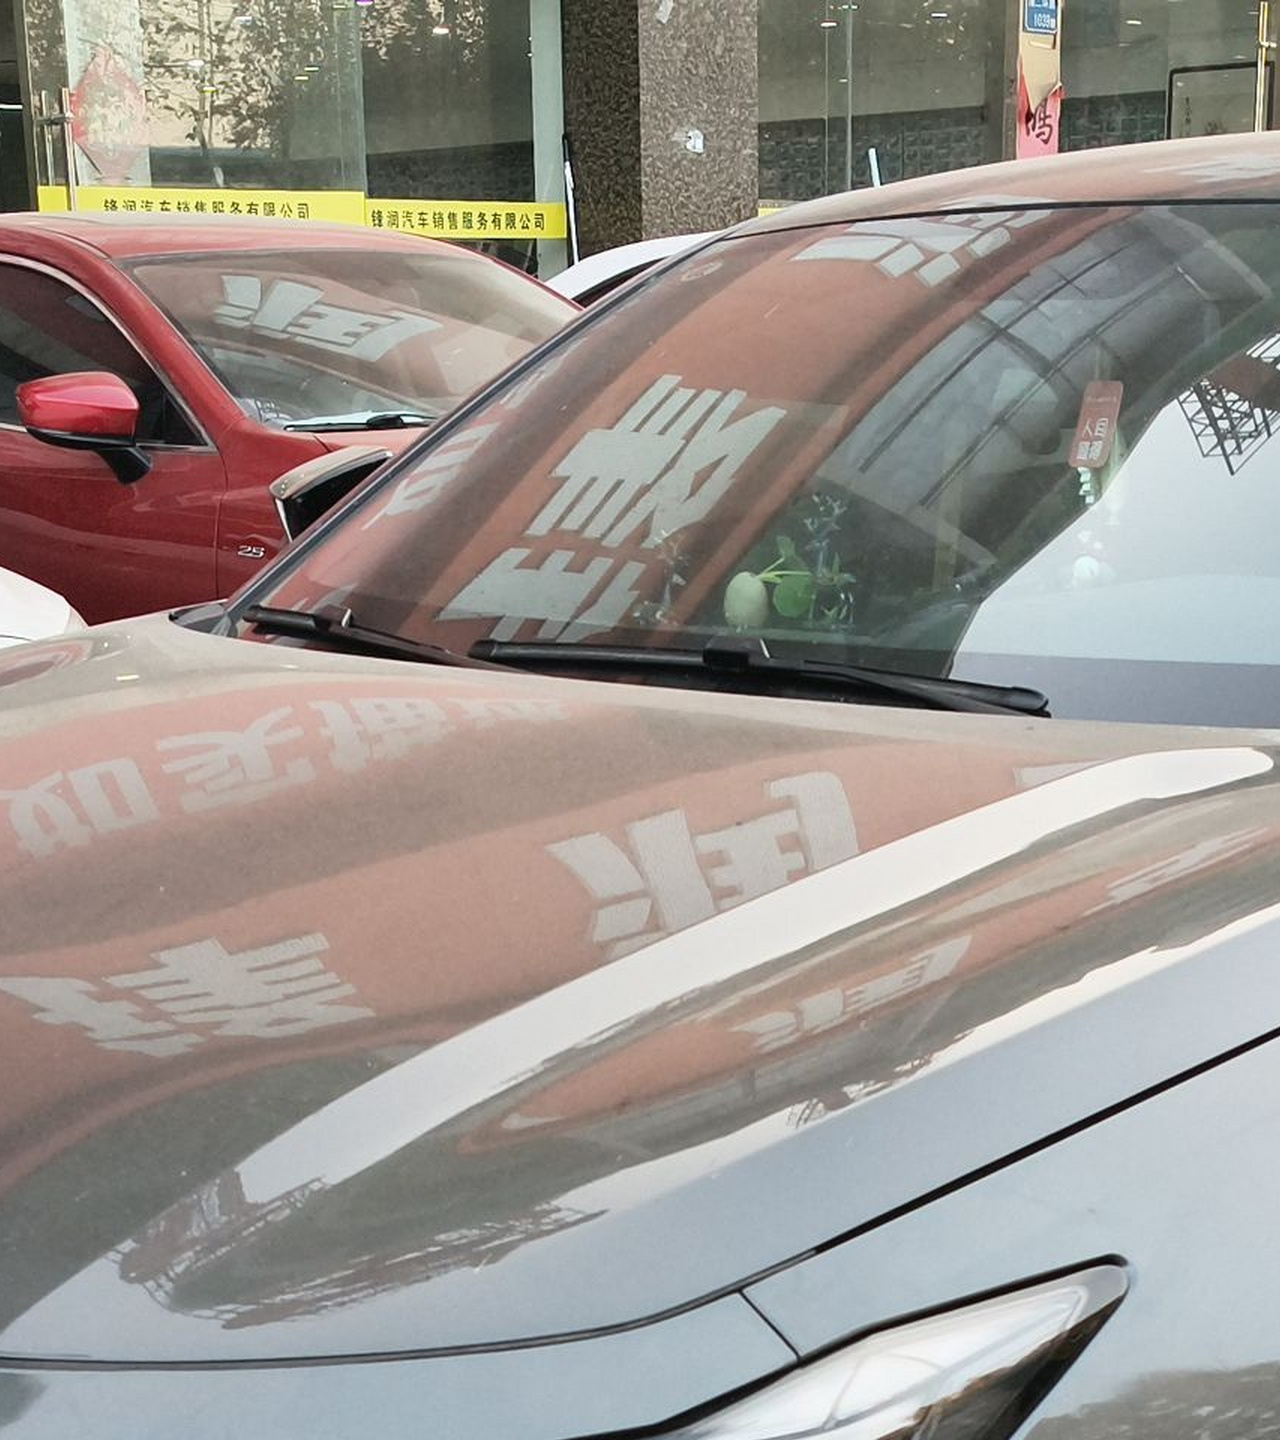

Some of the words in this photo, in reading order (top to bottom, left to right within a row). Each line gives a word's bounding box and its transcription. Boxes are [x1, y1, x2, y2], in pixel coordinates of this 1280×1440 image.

[371, 210, 546, 231] 锋润汽车销售服务有限公司
